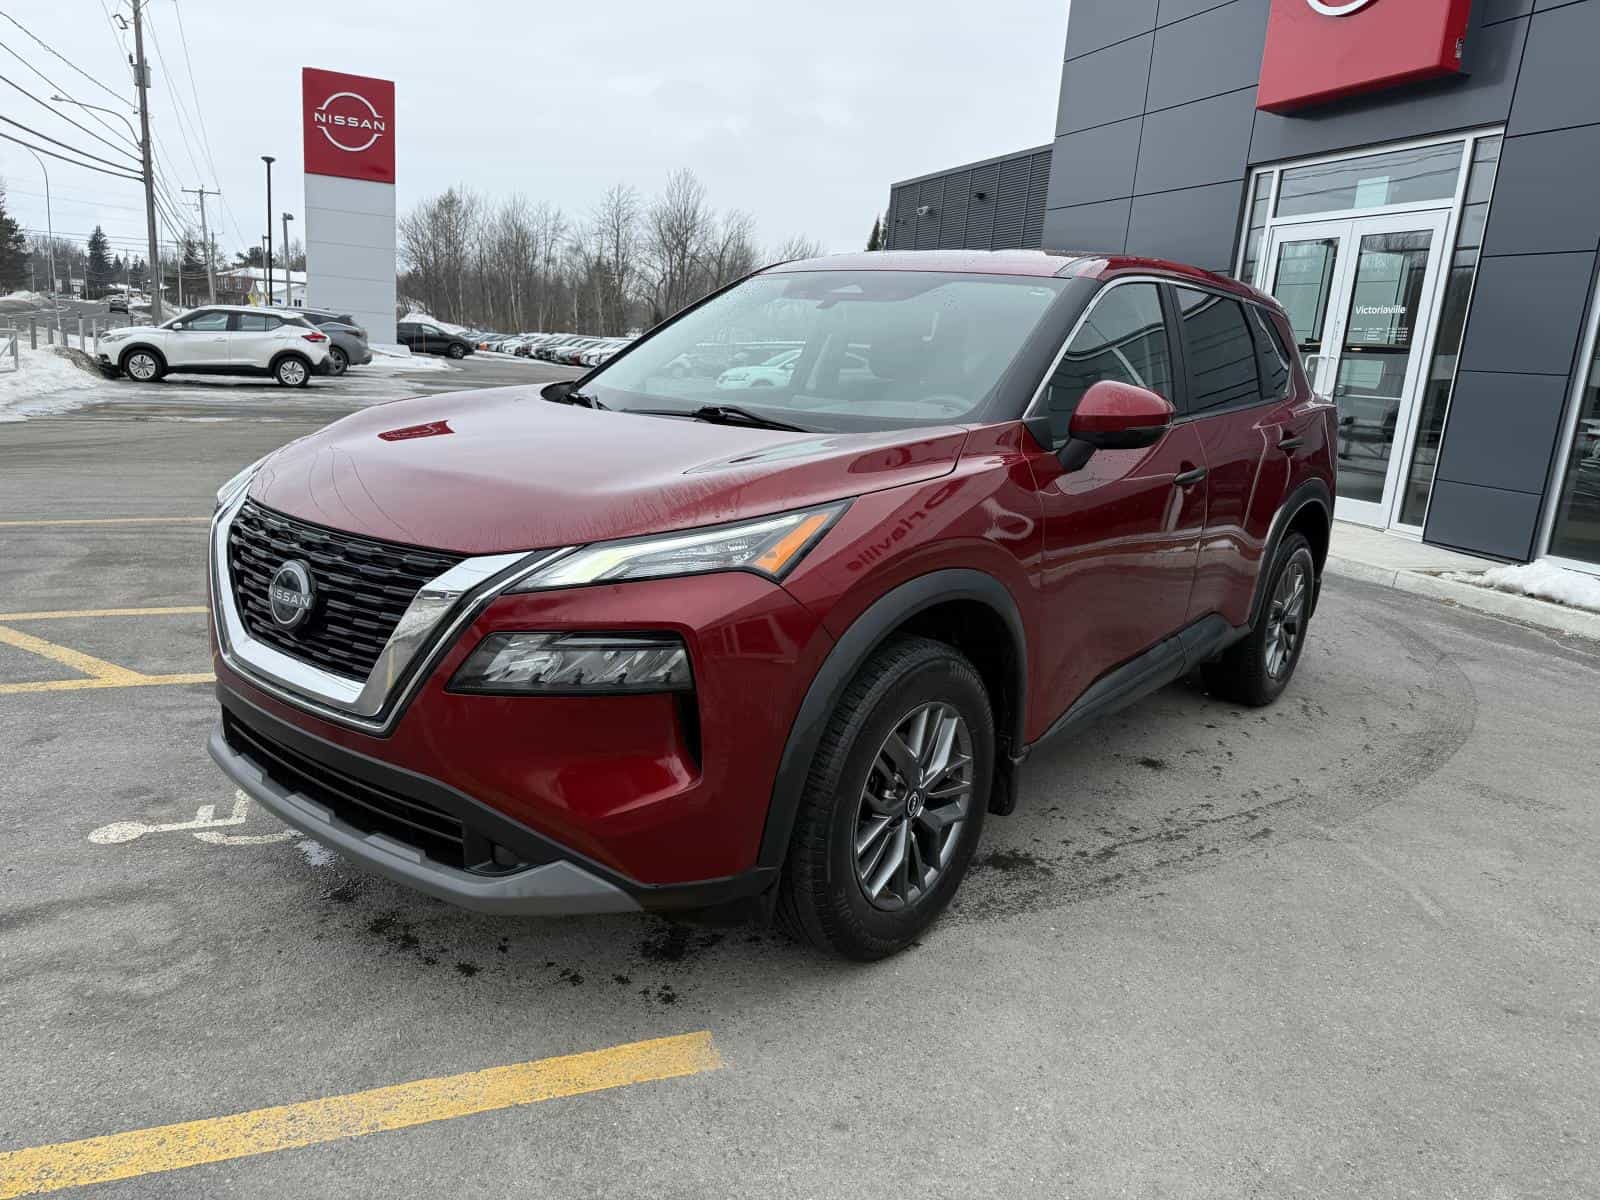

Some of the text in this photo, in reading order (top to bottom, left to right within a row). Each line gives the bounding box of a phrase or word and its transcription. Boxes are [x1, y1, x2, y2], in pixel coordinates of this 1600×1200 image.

[314, 112, 385, 131] NISSAN
[1355, 304, 1407, 314] Victoriaville
[270, 588, 311, 608] ISSAN
